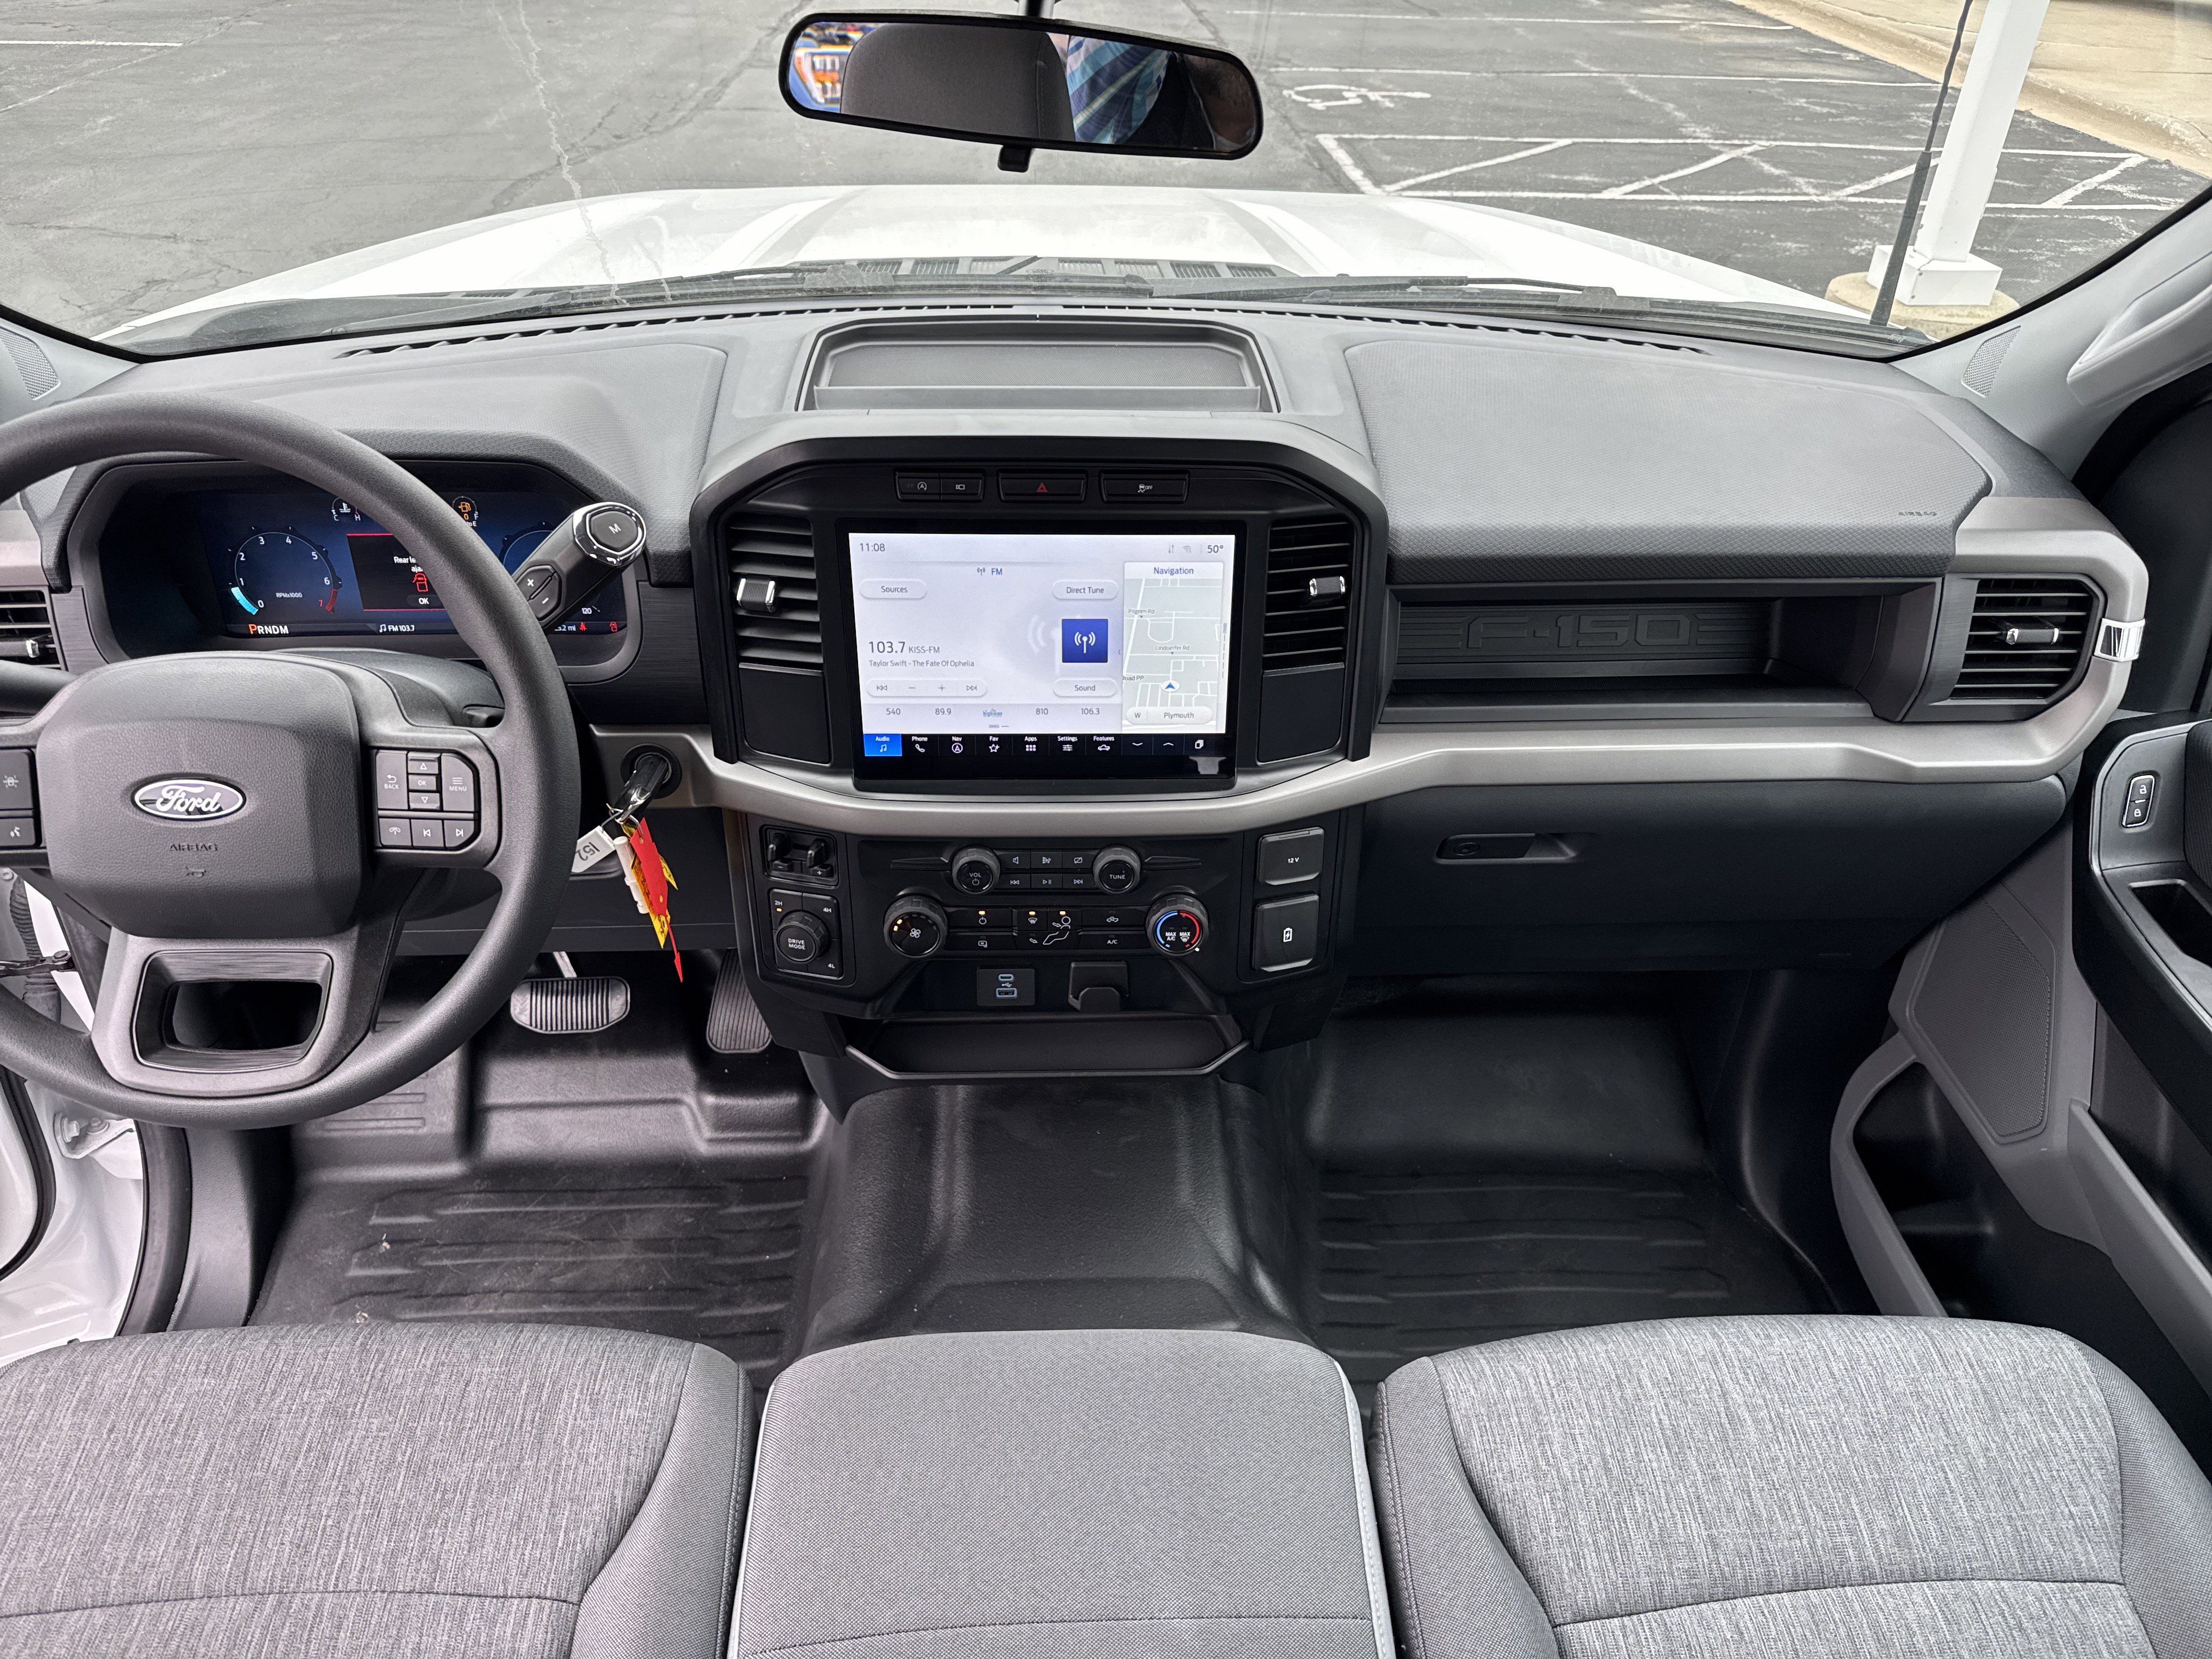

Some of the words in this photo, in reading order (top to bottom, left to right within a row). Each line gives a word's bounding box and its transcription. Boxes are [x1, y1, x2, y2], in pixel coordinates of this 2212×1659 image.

[608, 523, 622, 534] M
[258, 536, 265, 545] 3
[286, 536, 292, 544] 4
[859, 543, 885, 552] 11:08
[1207, 545, 1223, 553] 50°
[239, 552, 246, 561] 2
[312, 551, 318, 560] 5
[1153, 567, 1194, 577] Navigation
[239, 578, 244, 586] 1
[324, 577, 330, 585] 6
[257, 600, 264, 608] 0
[318, 599, 323, 607] 7
[1466, 613, 1691, 648] F-150
[868, 641, 906, 653] 103.7
[1164, 712, 1194, 720] Plymouth
[156, 785, 222, 812] Ford
[169, 843, 218, 851] AIRBAG
